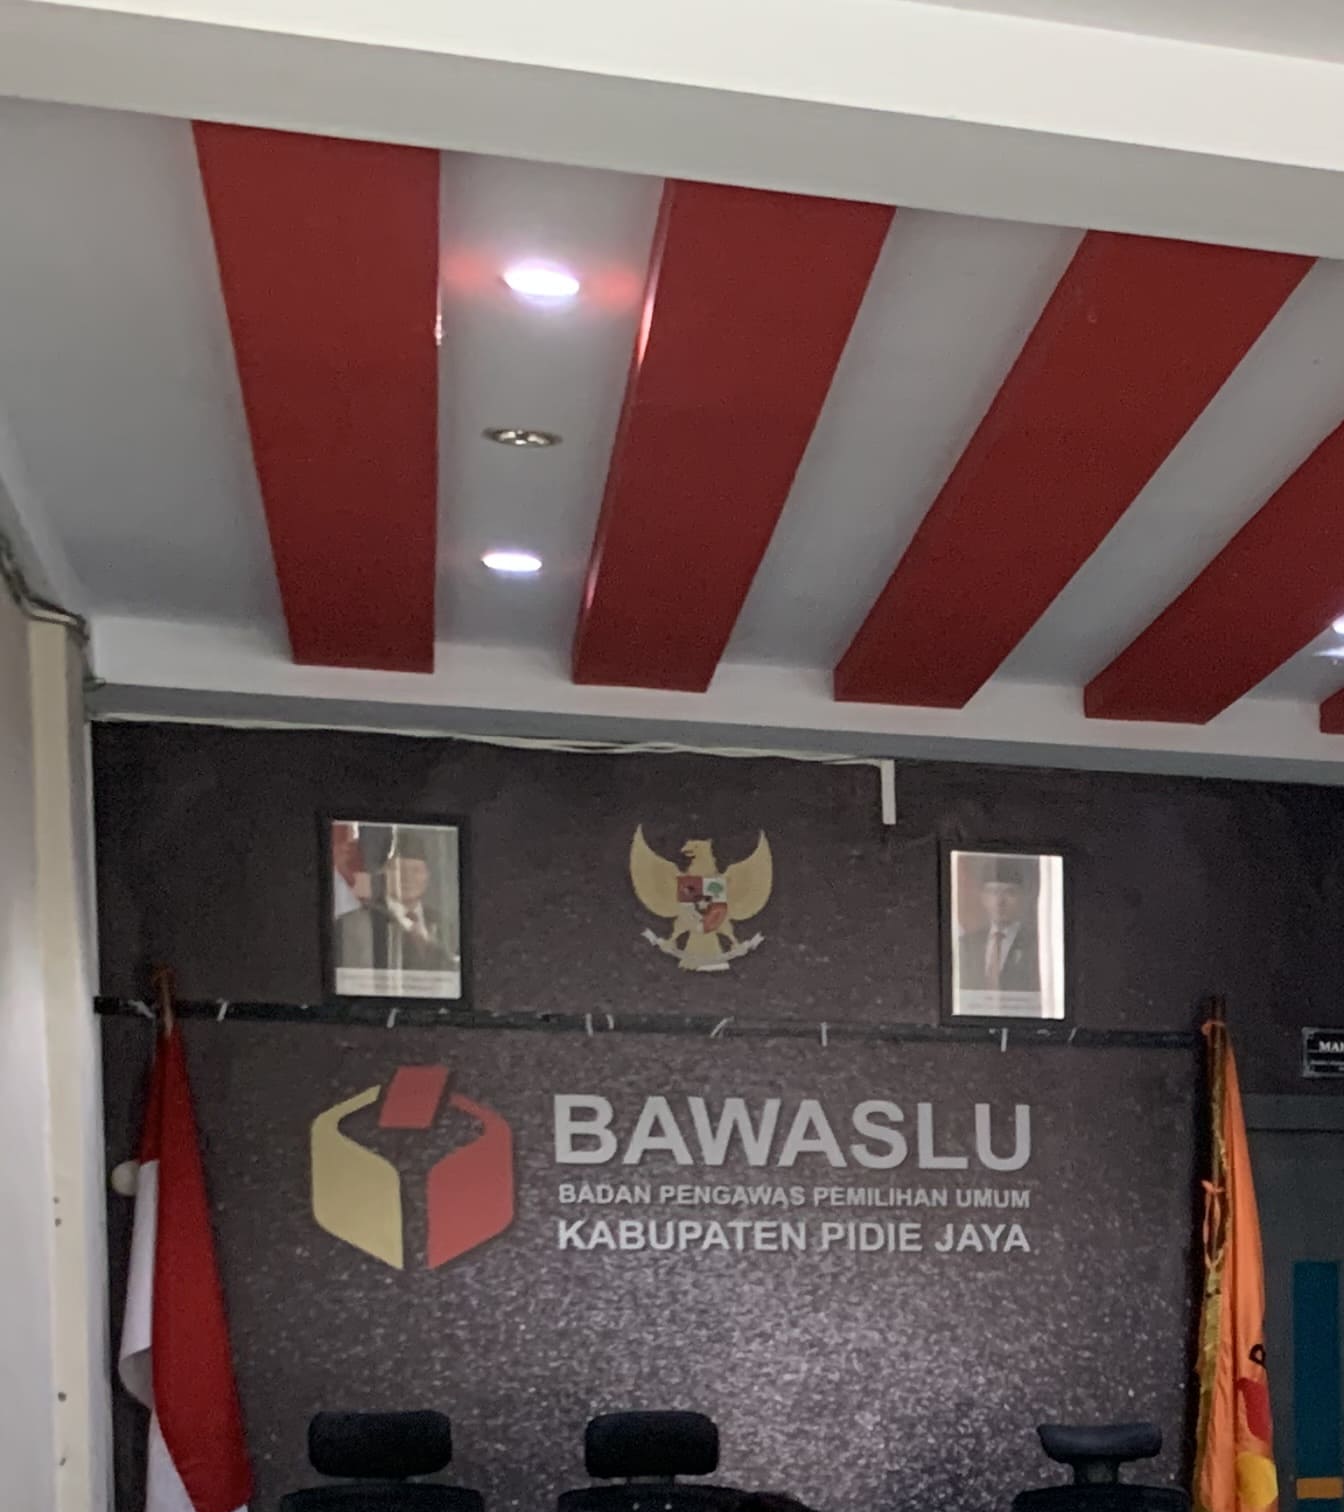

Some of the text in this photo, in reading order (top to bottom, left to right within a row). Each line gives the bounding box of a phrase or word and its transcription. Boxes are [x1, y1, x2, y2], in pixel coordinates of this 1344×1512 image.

[553, 1093, 1031, 1171] BAWASLU
[558, 1183, 1030, 1209] BADAN PENGAWAS PEMILIHAN UMUM
[556, 1219, 1031, 1254] KABUPATEN PIDIE JAYA
